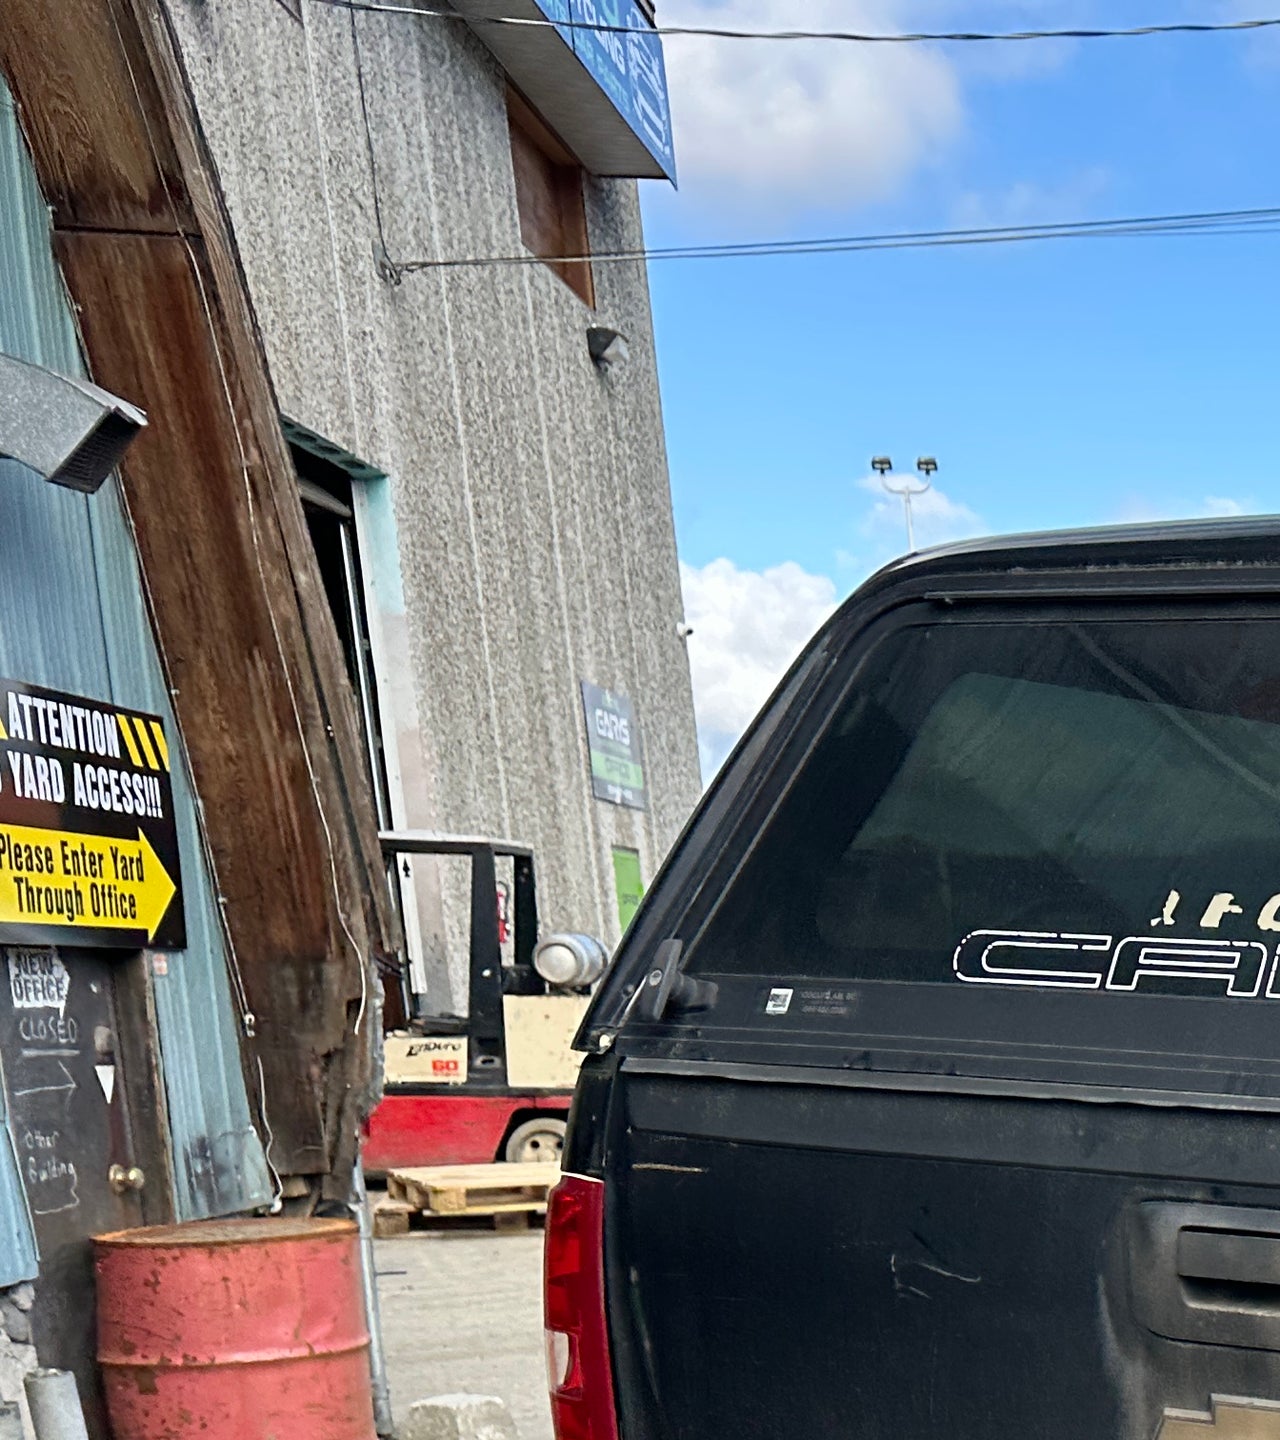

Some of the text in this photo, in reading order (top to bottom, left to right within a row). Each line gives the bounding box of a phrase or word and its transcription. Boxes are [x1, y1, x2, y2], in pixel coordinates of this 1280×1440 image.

[7, 691, 120, 758] ATTENTION
[7, 751, 65, 803] YARD
[73, 762, 163, 818] ACCESS!!!
[60, 840, 104, 878] Enter
[110, 846, 144, 882] Yard
[13, 877, 136, 922] Through Office
[13, 977, 65, 1002] OFFICE
[20, 1018, 77, 1043] CLOSED
